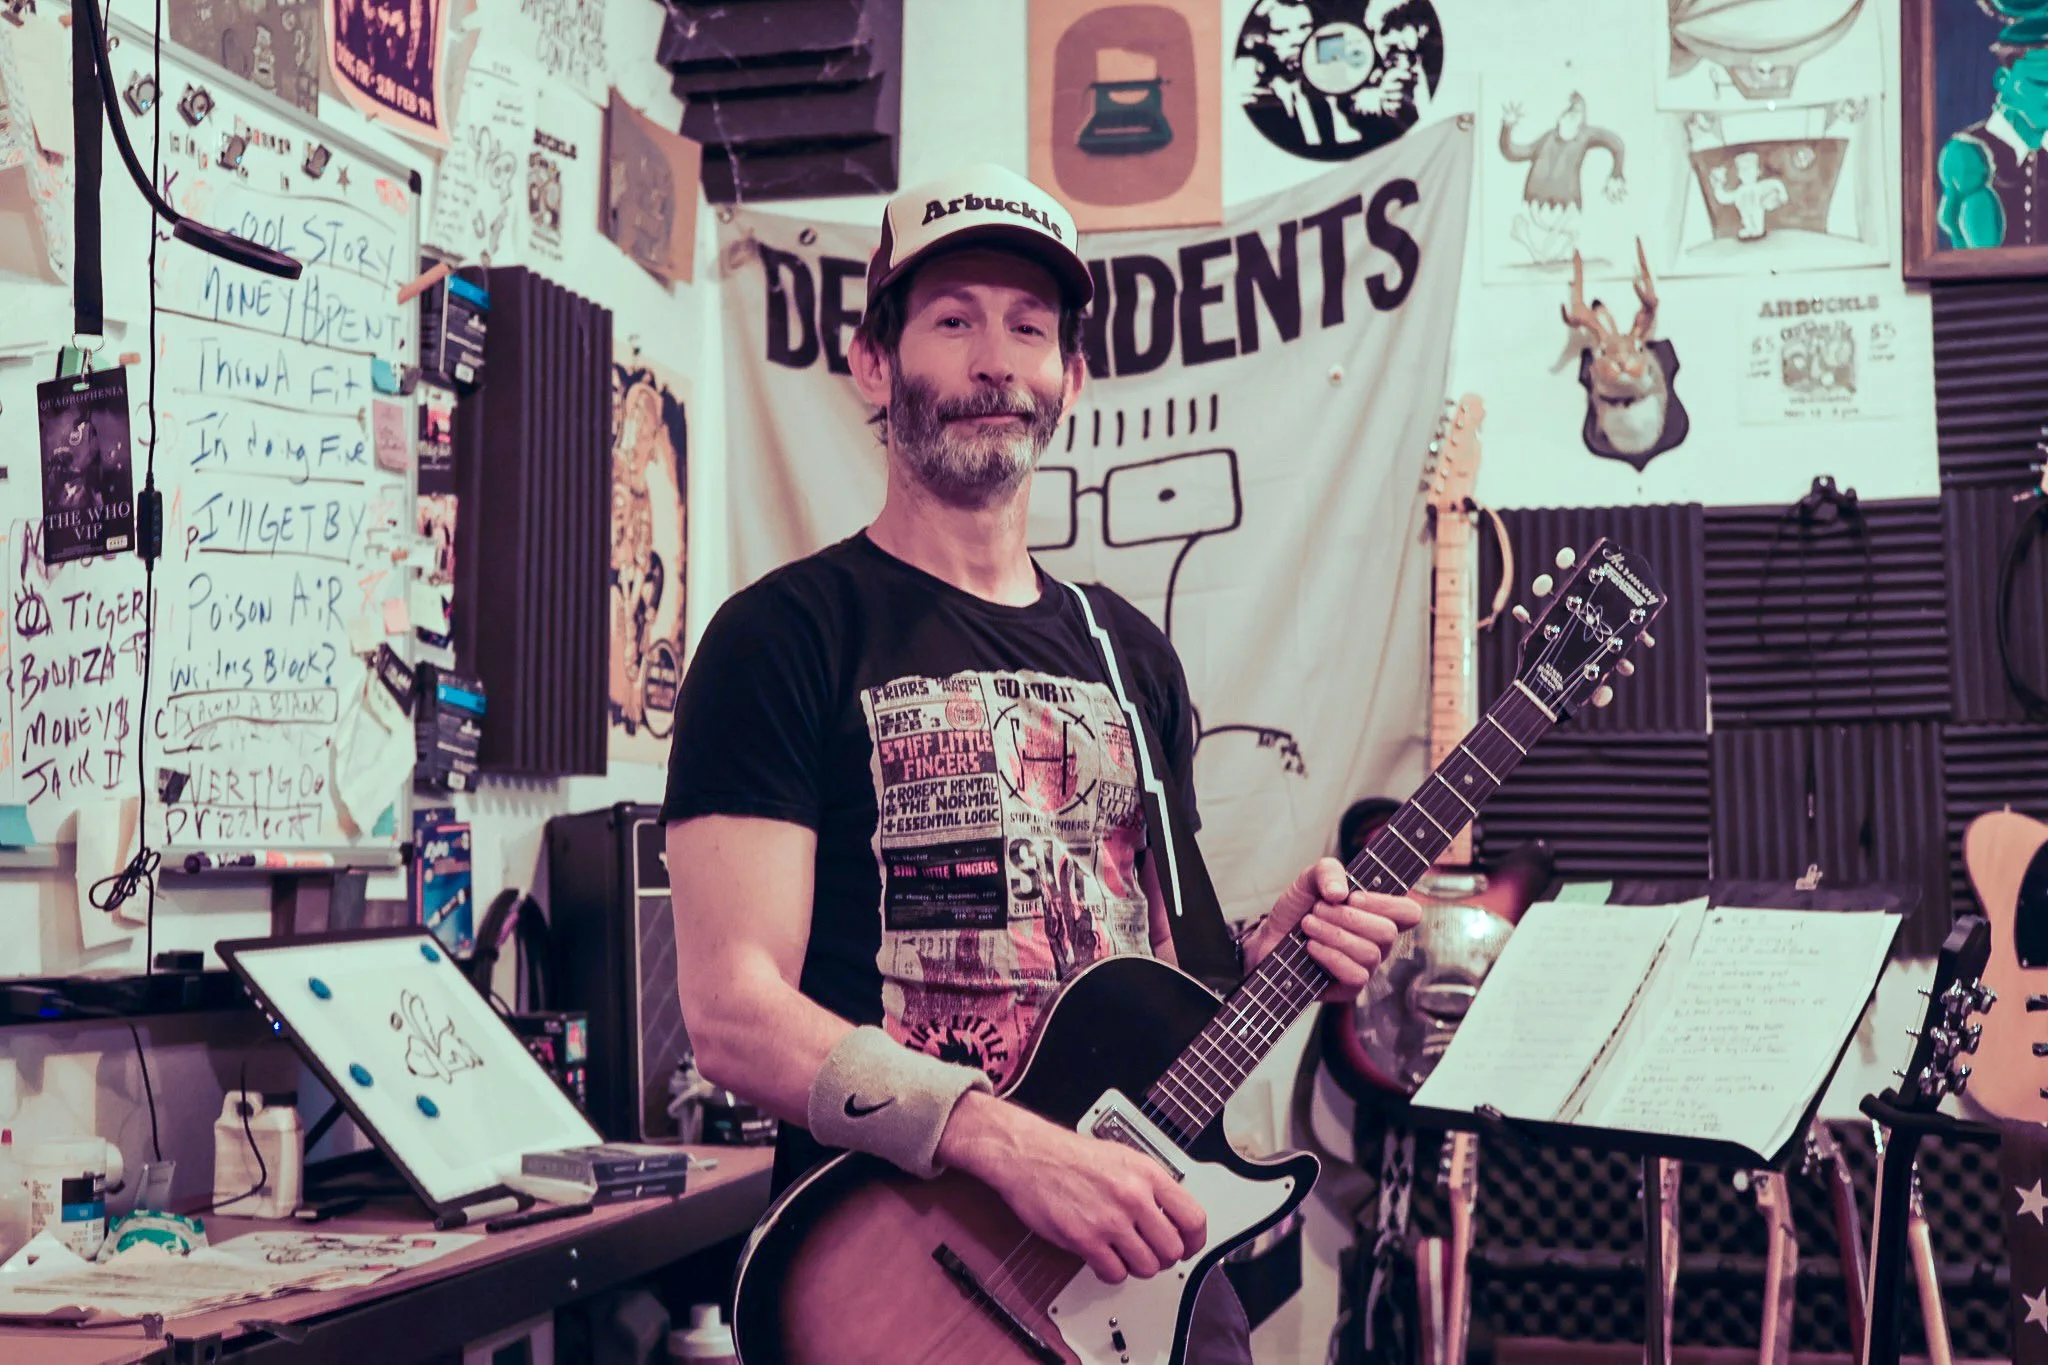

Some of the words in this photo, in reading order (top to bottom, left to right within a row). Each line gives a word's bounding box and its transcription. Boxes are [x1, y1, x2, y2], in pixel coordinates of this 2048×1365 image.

[921, 193, 1063, 240] Arbuckle
[302, 213, 396, 292] STORY
[757, 178, 1420, 380] DEDENTS
[45, 510, 81, 531] THE
[87, 500, 131, 523] WHO
[74, 524, 103, 541] VIP
[871, 680, 929, 705] FRIARS
[993, 679, 1020, 699] GO
[881, 733, 932, 765] STIFF
[938, 731, 994, 754] LITTLE
[903, 752, 981, 782] FINGERS
[950, 777, 998, 794] RENTAL
[899, 798, 930, 816] THE
[936, 791, 999, 812] NORMAL
[964, 808, 1000, 825] LOGIC
[955, 860, 999, 878] FINGERS
